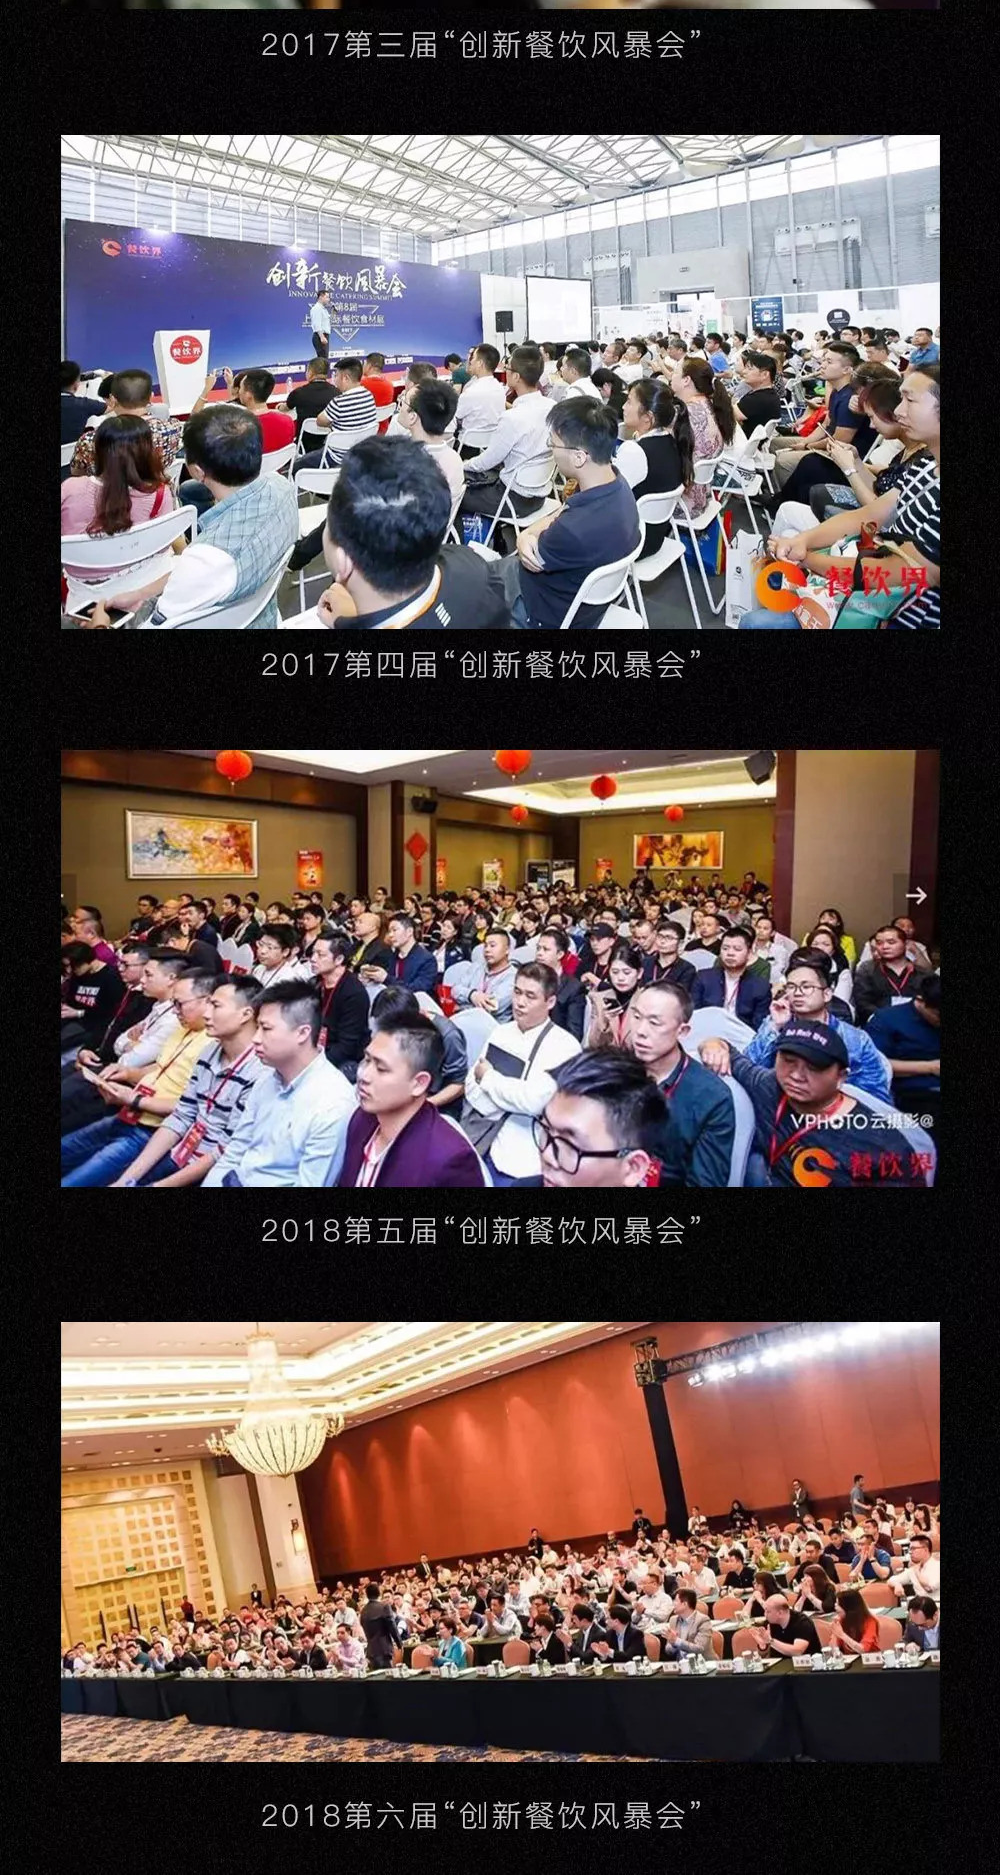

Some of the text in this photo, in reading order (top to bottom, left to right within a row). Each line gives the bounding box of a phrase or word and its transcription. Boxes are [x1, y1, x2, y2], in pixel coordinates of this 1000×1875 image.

[127, 244, 162, 256] 餐饮界
[266, 258, 407, 299] 创新餐饮风暴会
[172, 346, 201, 357] 餐饮界
